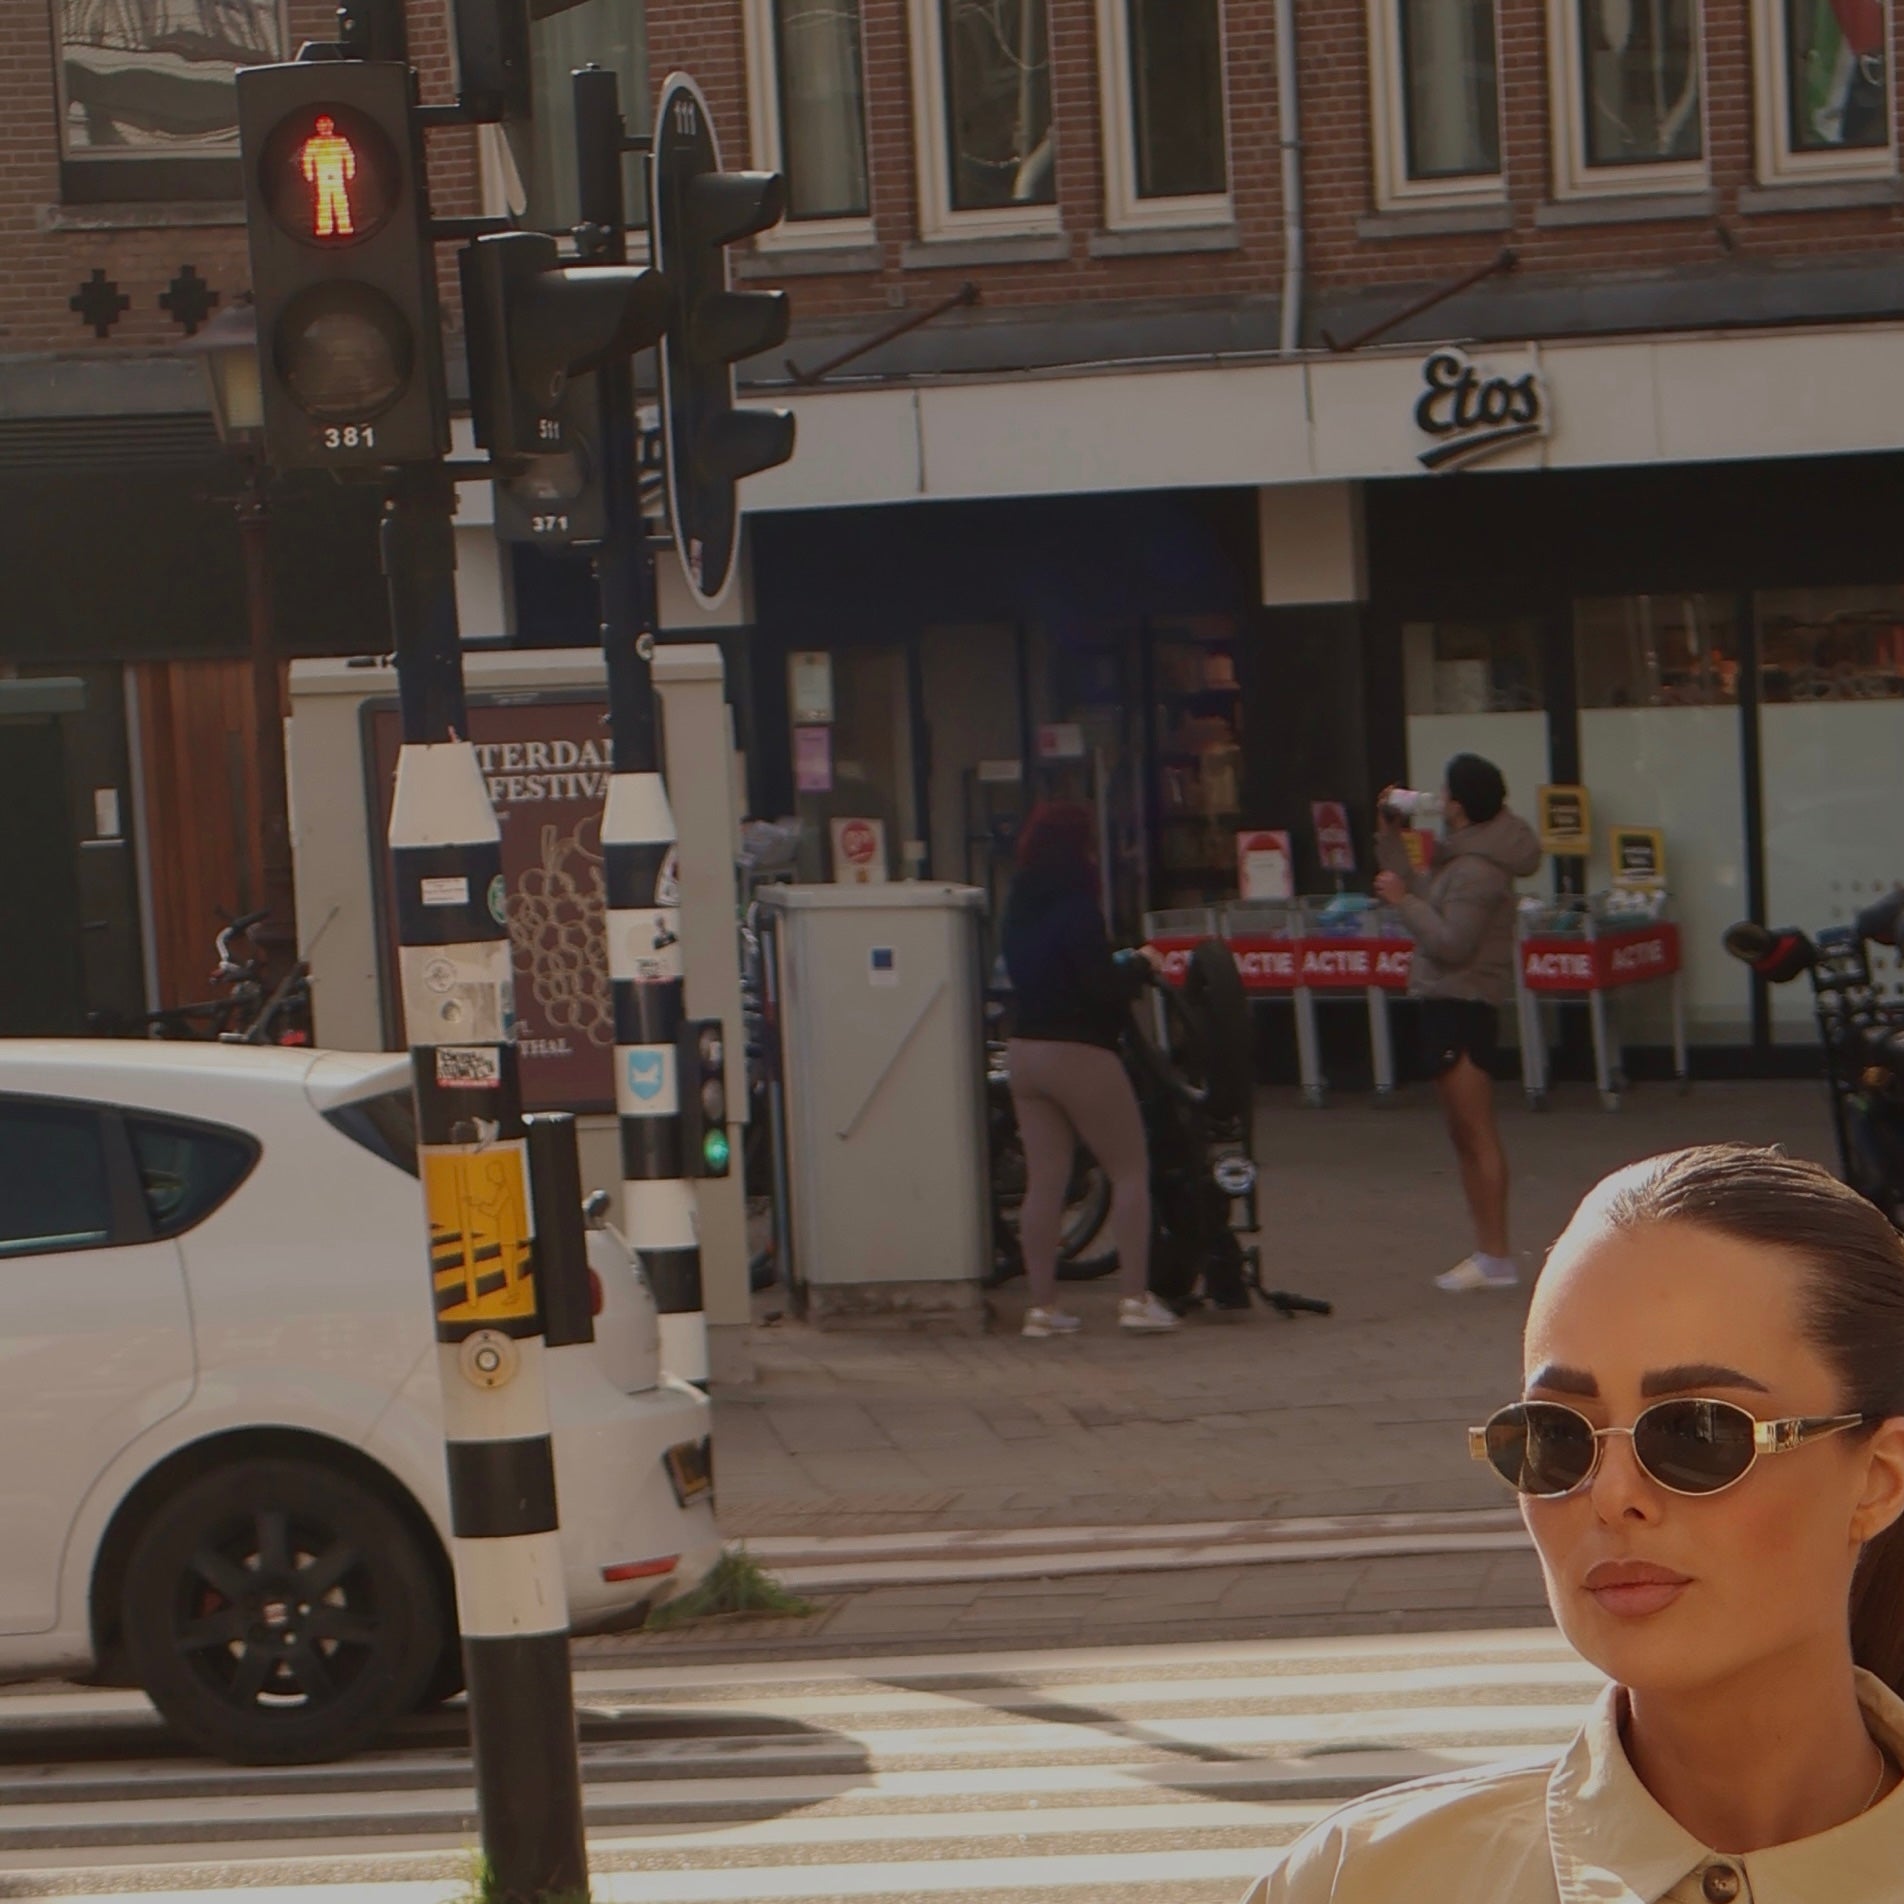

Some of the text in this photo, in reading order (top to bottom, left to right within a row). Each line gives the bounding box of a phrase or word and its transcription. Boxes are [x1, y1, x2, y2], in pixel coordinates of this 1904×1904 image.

[1414, 353, 1543, 434] Etos
[324, 426, 375, 448] 381
[538, 419, 560, 440] 511
[532, 515, 569, 533] 371
[474, 738, 615, 772] TERDA
[1304, 950, 1370, 976] ACTIE
[1526, 953, 1592, 979] ACTIE
[1611, 937, 1665, 972] ACTIE
